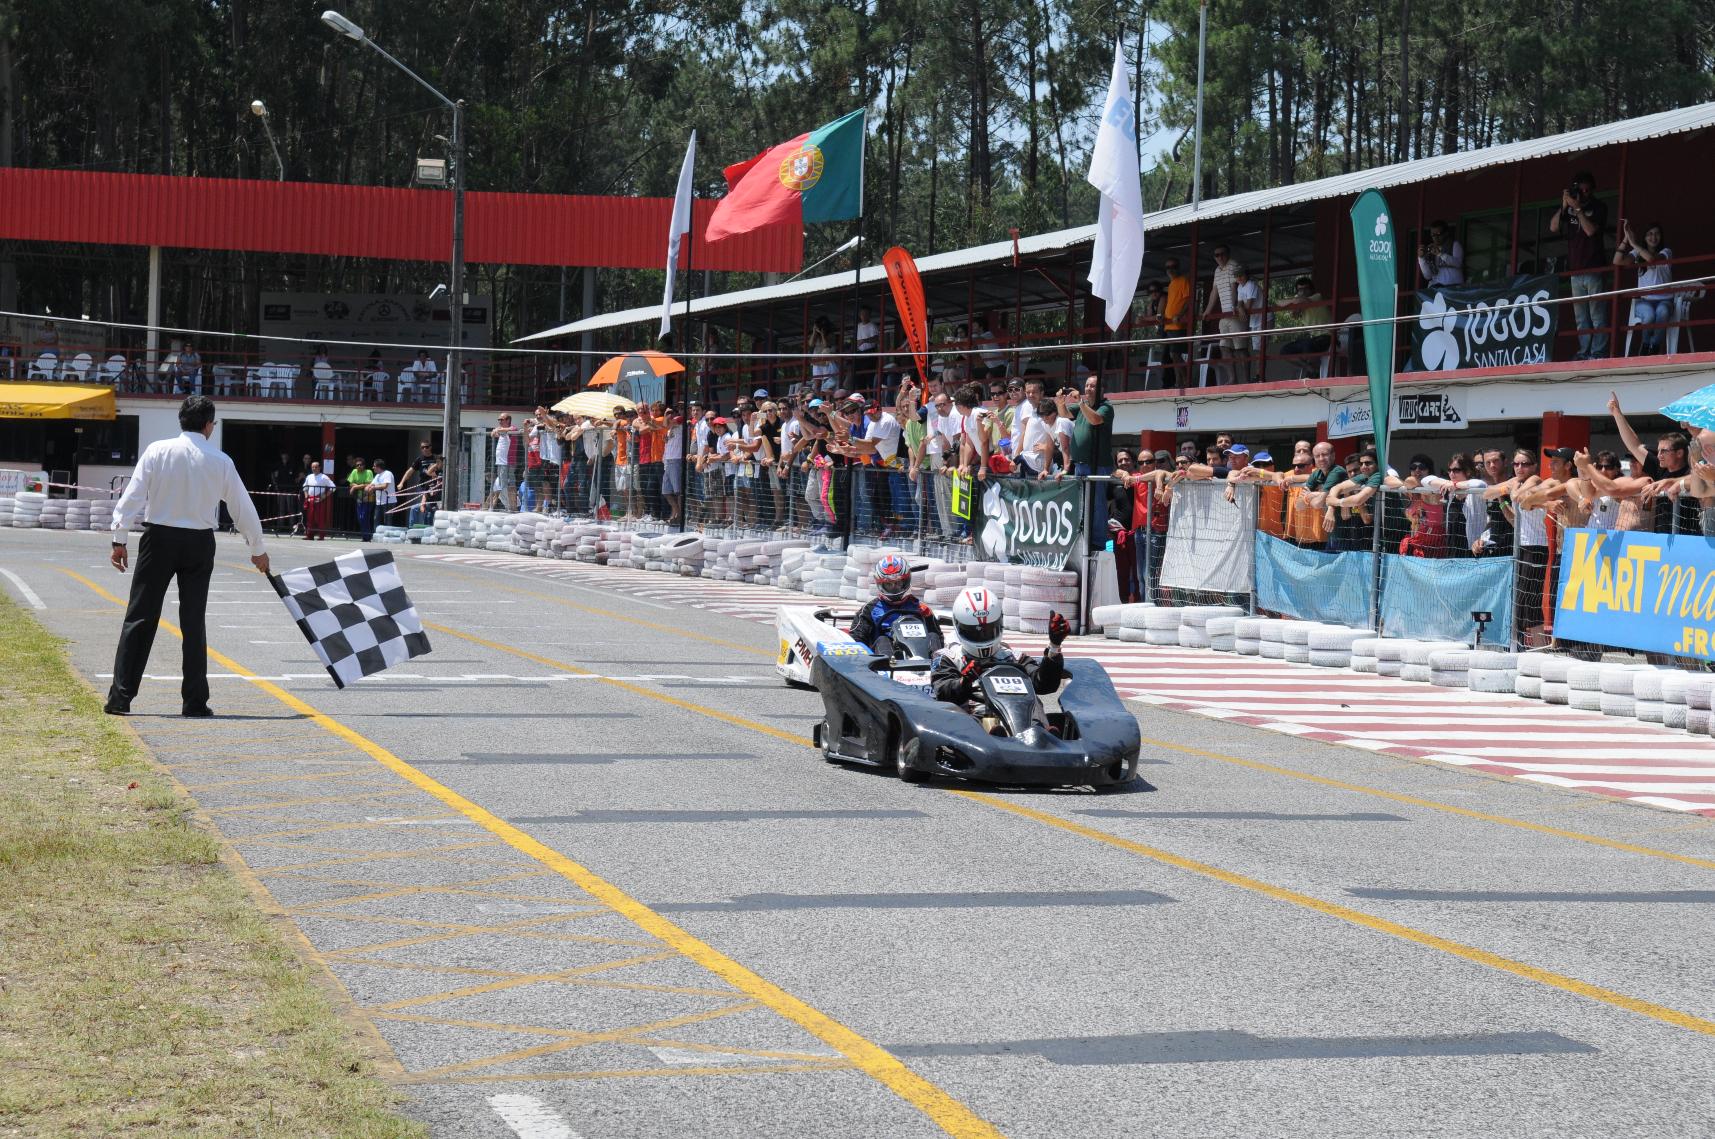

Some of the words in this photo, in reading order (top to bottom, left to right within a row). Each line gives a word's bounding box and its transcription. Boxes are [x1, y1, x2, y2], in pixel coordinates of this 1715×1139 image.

[1464, 290, 1551, 362] JOGOS
[1010, 499, 1073, 556] JOGOS
[1560, 533, 1661, 613] KART
[1673, 626, 1715, 656] .FR
[993, 677, 1022, 685] 108
